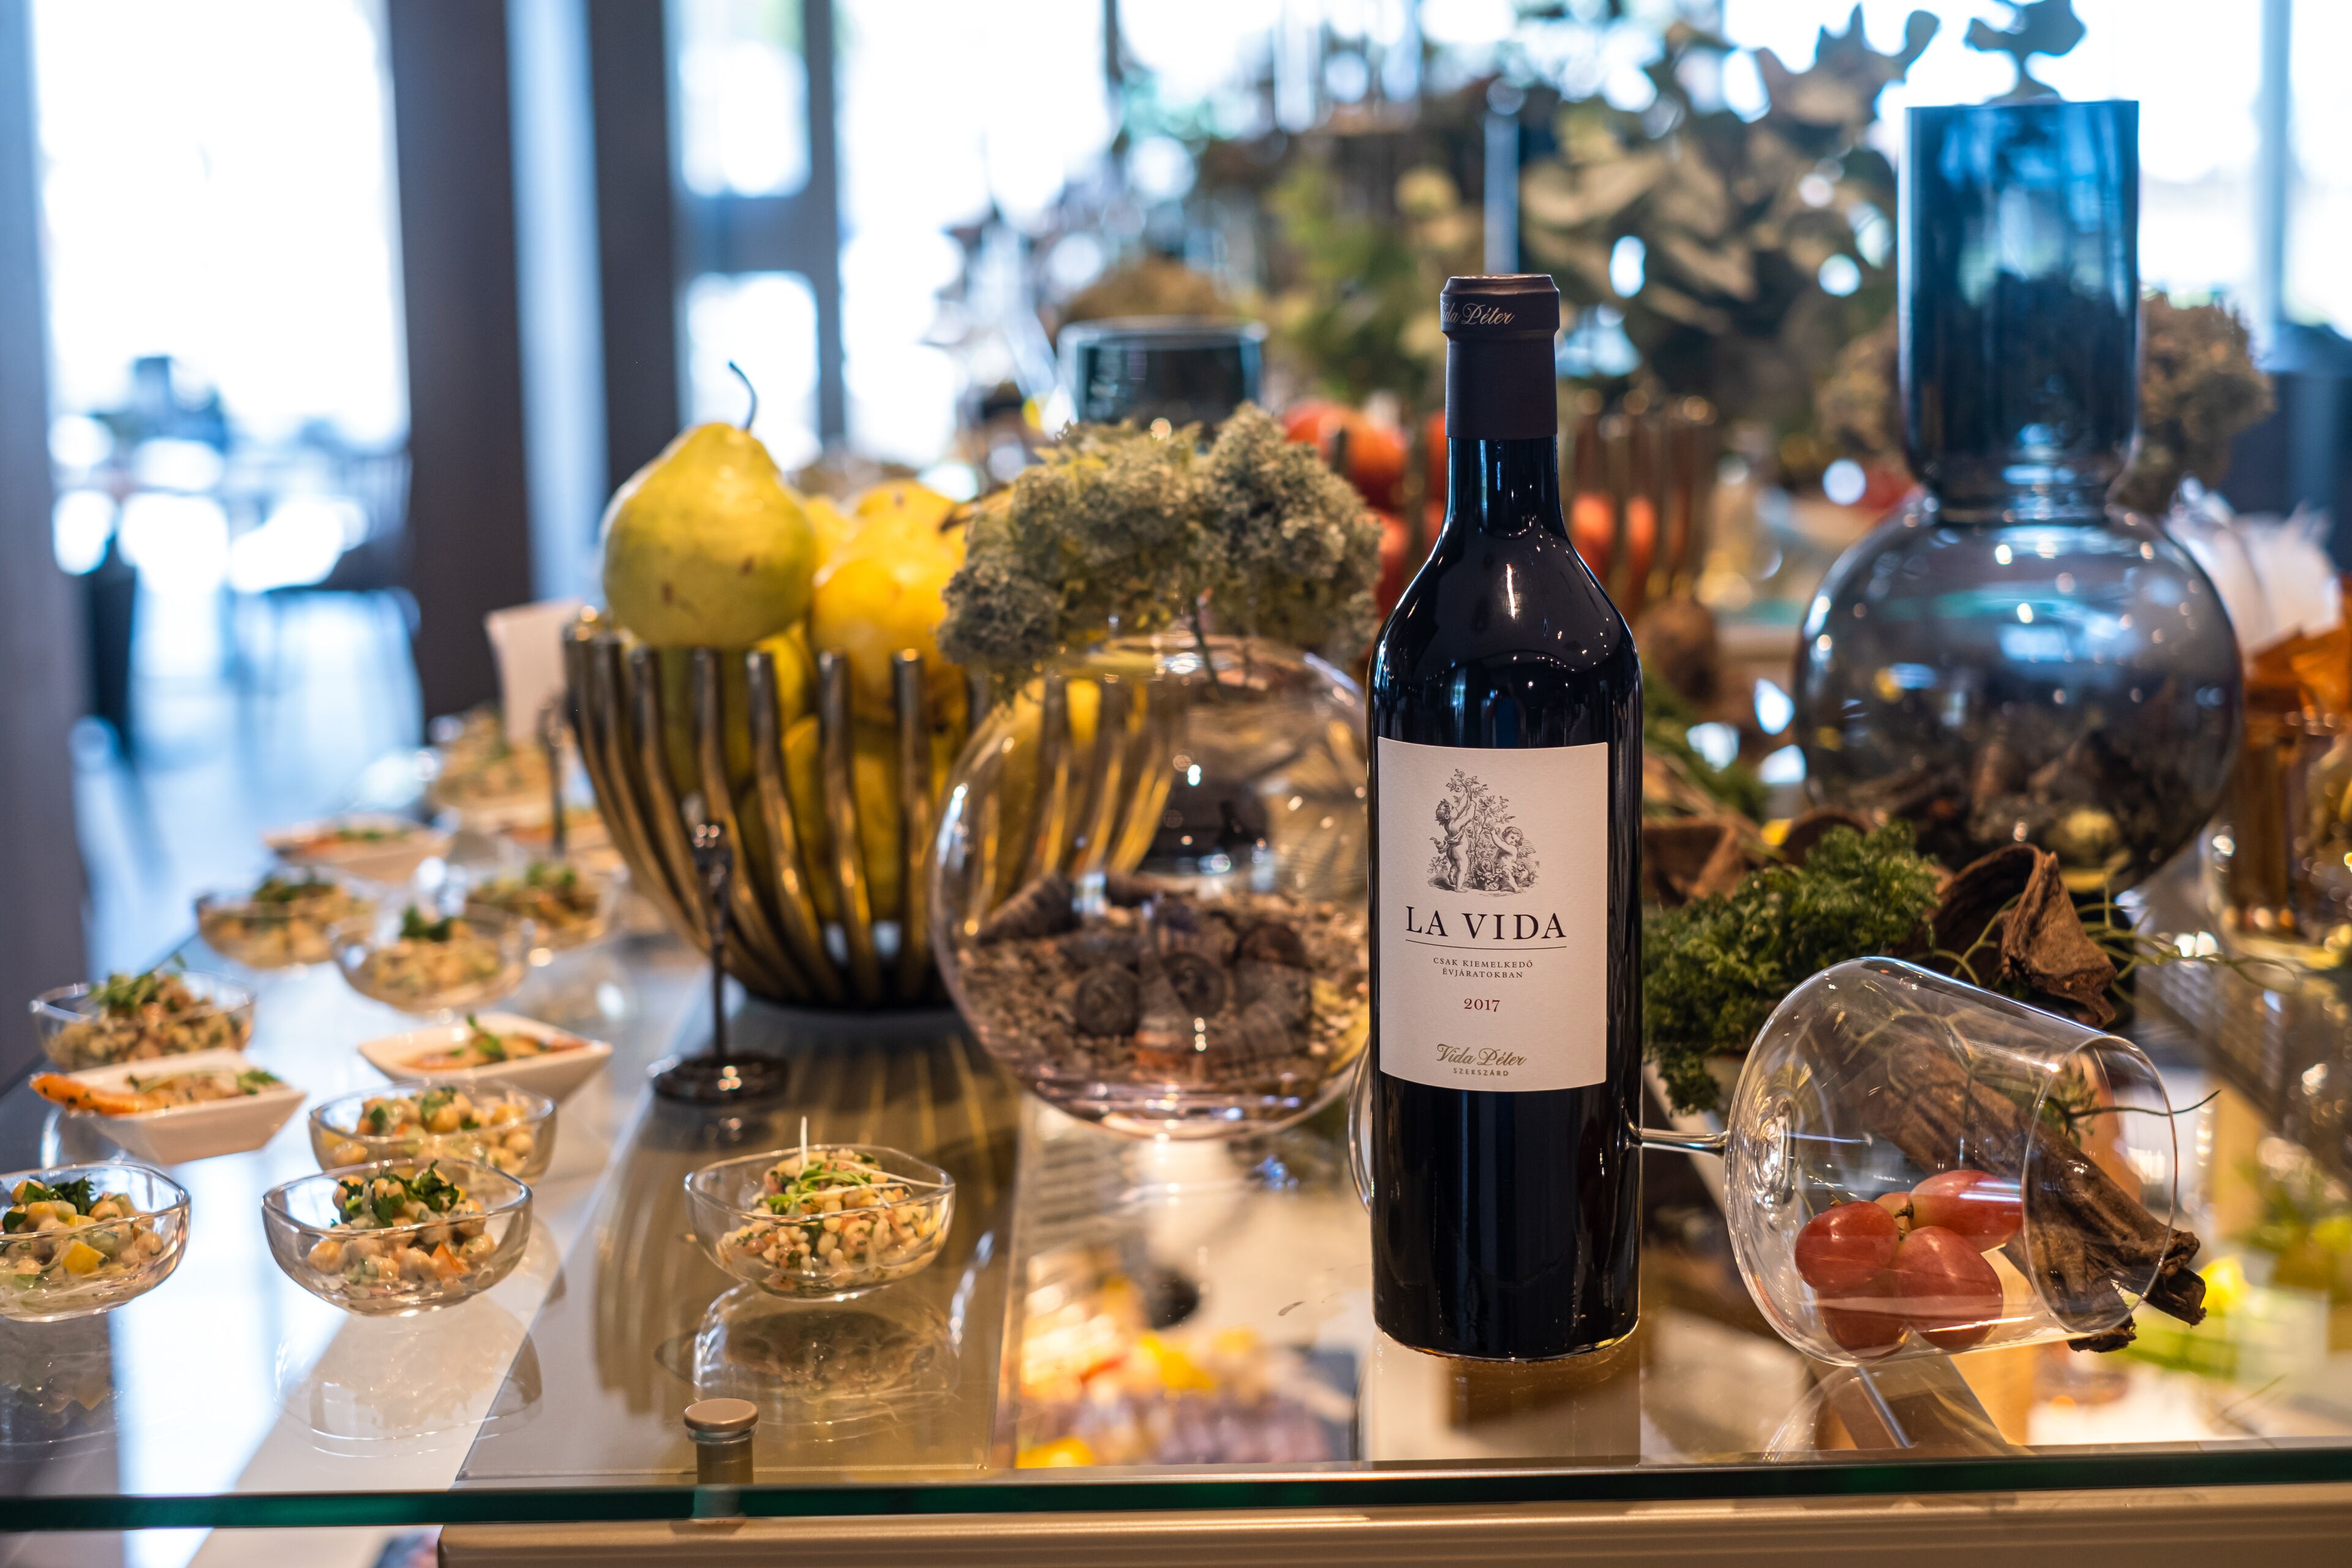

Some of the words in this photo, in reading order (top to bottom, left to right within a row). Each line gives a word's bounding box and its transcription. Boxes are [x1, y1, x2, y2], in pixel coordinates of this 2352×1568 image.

[1461, 303, 1515, 325] Péter
[1406, 906, 1448, 937] LA
[1461, 913, 1567, 940] VIDA
[1433, 957, 1458, 966] CSAK
[1442, 968, 1523, 978] ÉVJÁRATOKBAN
[1464, 998, 1500, 1012] 2017
[1436, 1044, 1476, 1065] Vida
[1477, 1048, 1526, 1066] Péter
[1453, 1068, 1509, 1077] SZEKSZÁRD
